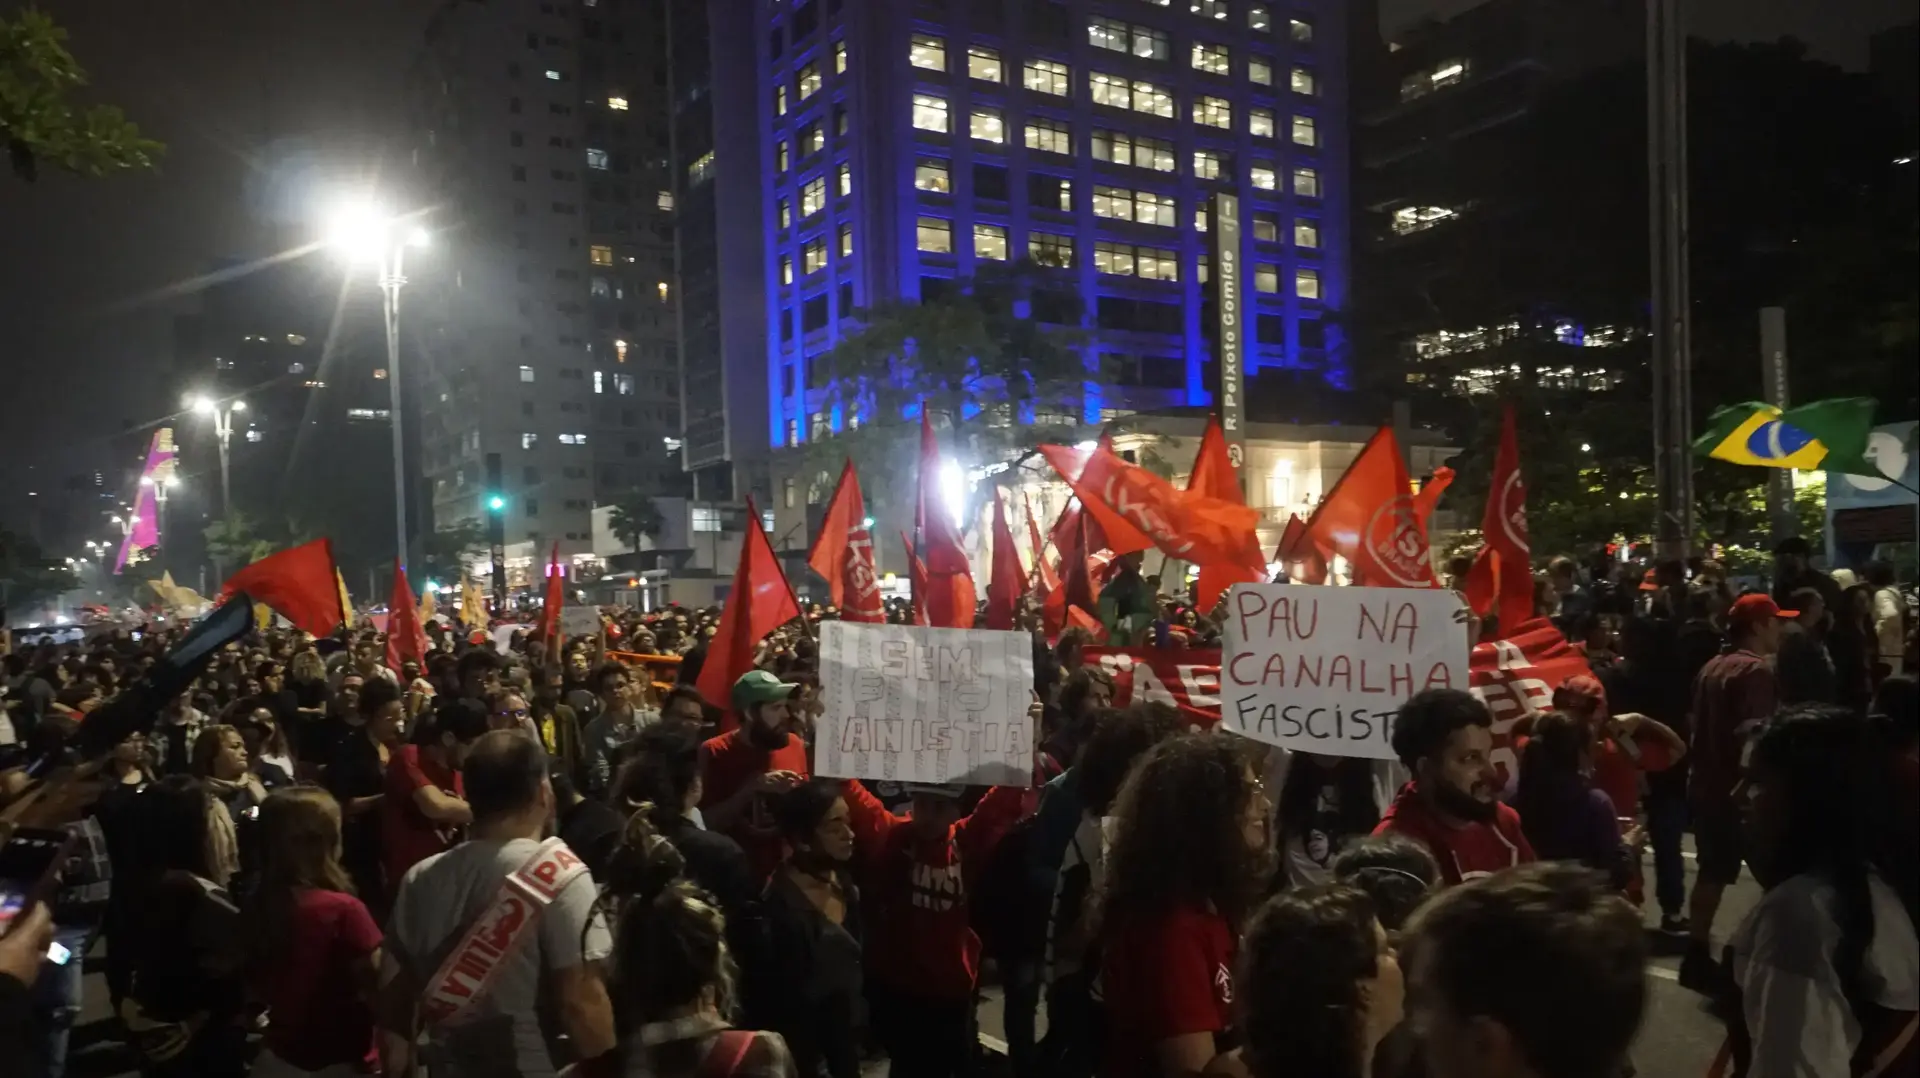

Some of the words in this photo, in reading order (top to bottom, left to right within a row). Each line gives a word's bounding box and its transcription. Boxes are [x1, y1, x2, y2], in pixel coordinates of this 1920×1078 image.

[1222, 250, 1234, 327] Gomide
[1224, 331, 1237, 407] Peixoto
[1225, 414, 1237, 430] R.
[1236, 591, 1318, 642] PAU
[1357, 601, 1419, 654] NA
[881, 641, 974, 683] SEM
[1229, 651, 1452, 697] CANALHA
[841, 716, 1028, 755] ANISTIA
[1236, 693, 1400, 744] FASCIST
